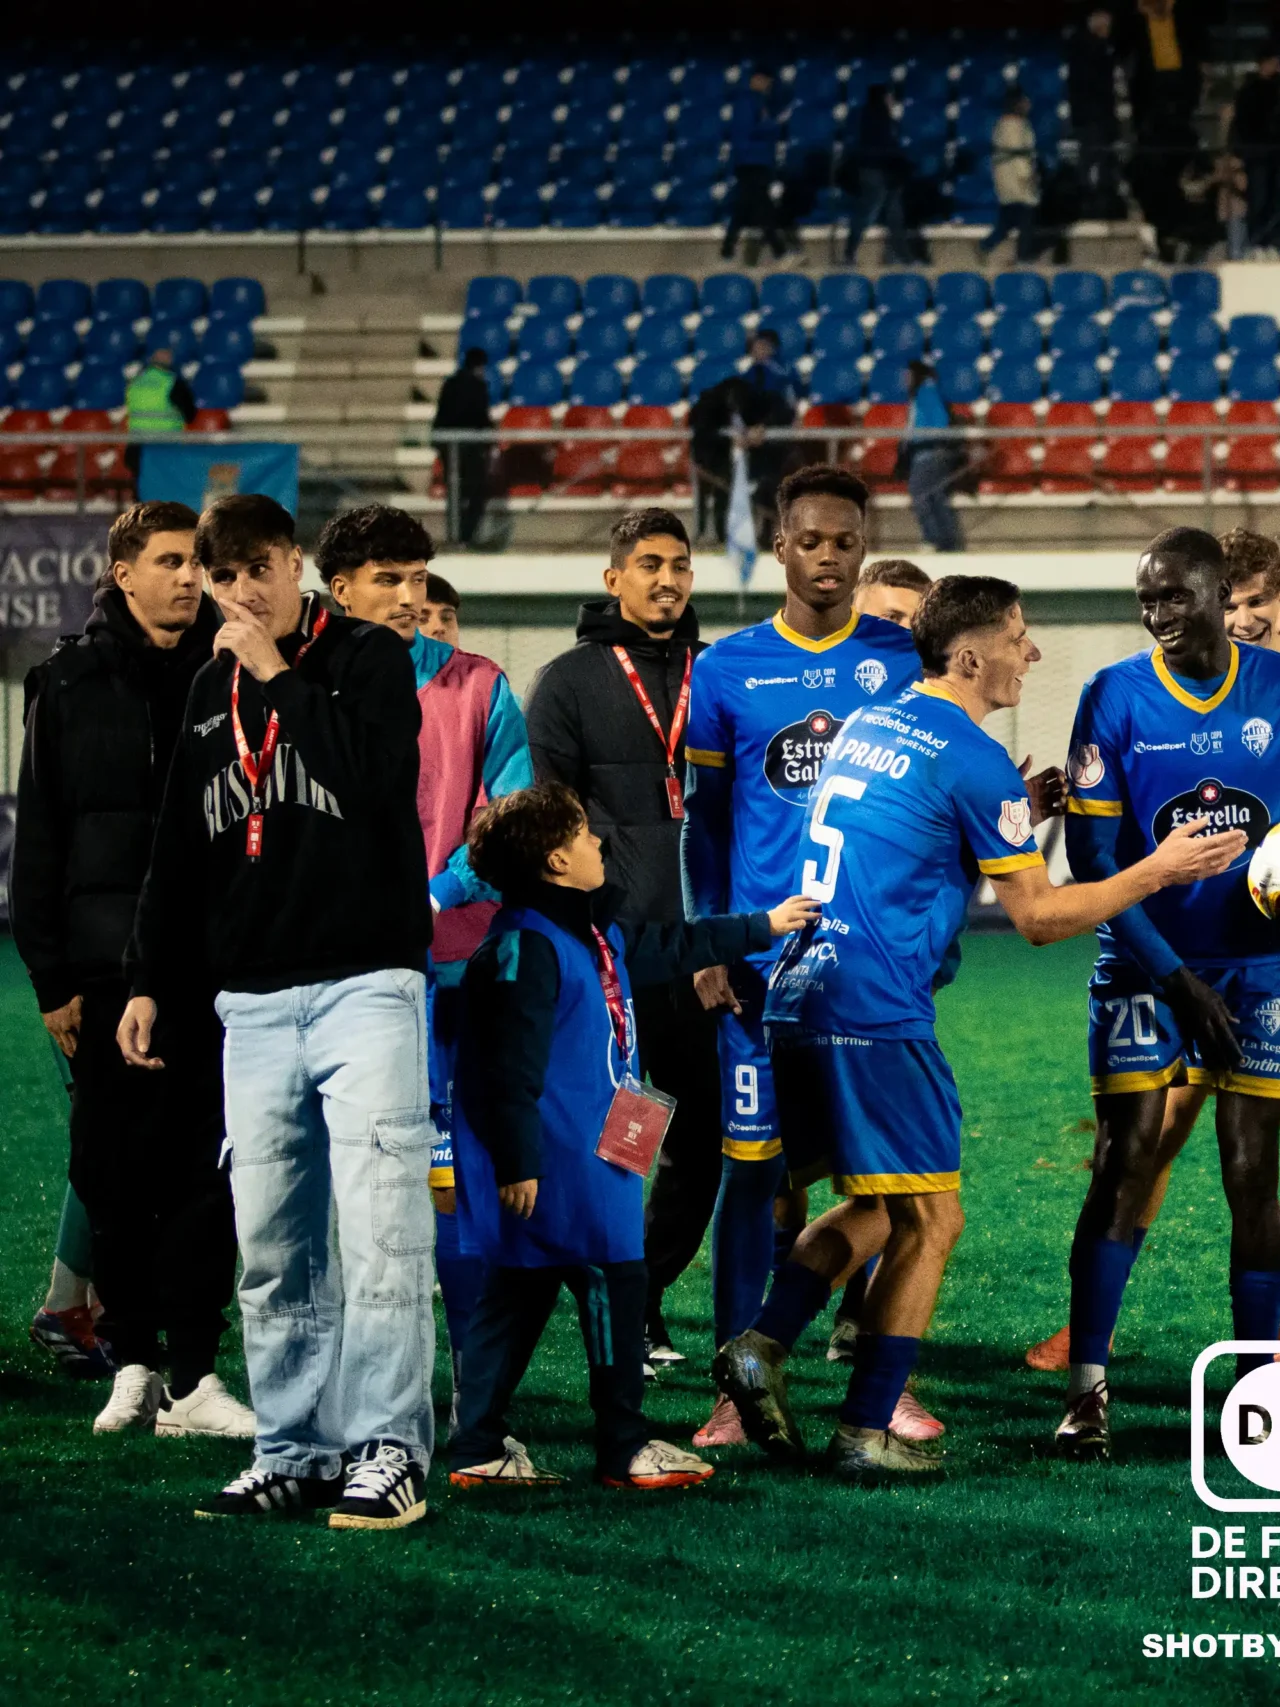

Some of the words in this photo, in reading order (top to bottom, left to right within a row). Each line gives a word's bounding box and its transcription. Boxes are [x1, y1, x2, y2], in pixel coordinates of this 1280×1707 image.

[0, 541, 108, 587] ACIÓ
[861, 712, 912, 734] recoletas
[911, 728, 949, 750] salud
[781, 738, 832, 760] Estre
[837, 738, 911, 779] PRADO
[895, 735, 939, 760] OURENSE
[784, 761, 823, 783] Gal
[1170, 803, 1251, 829] Estrella
[802, 775, 868, 903] 5
[785, 965, 810, 976] UNTA
[789, 977, 824, 993] GALICIA
[1104, 994, 1157, 1048] 20
[1241, 1038, 1258, 1050] La
[735, 1064, 759, 1115] 9
